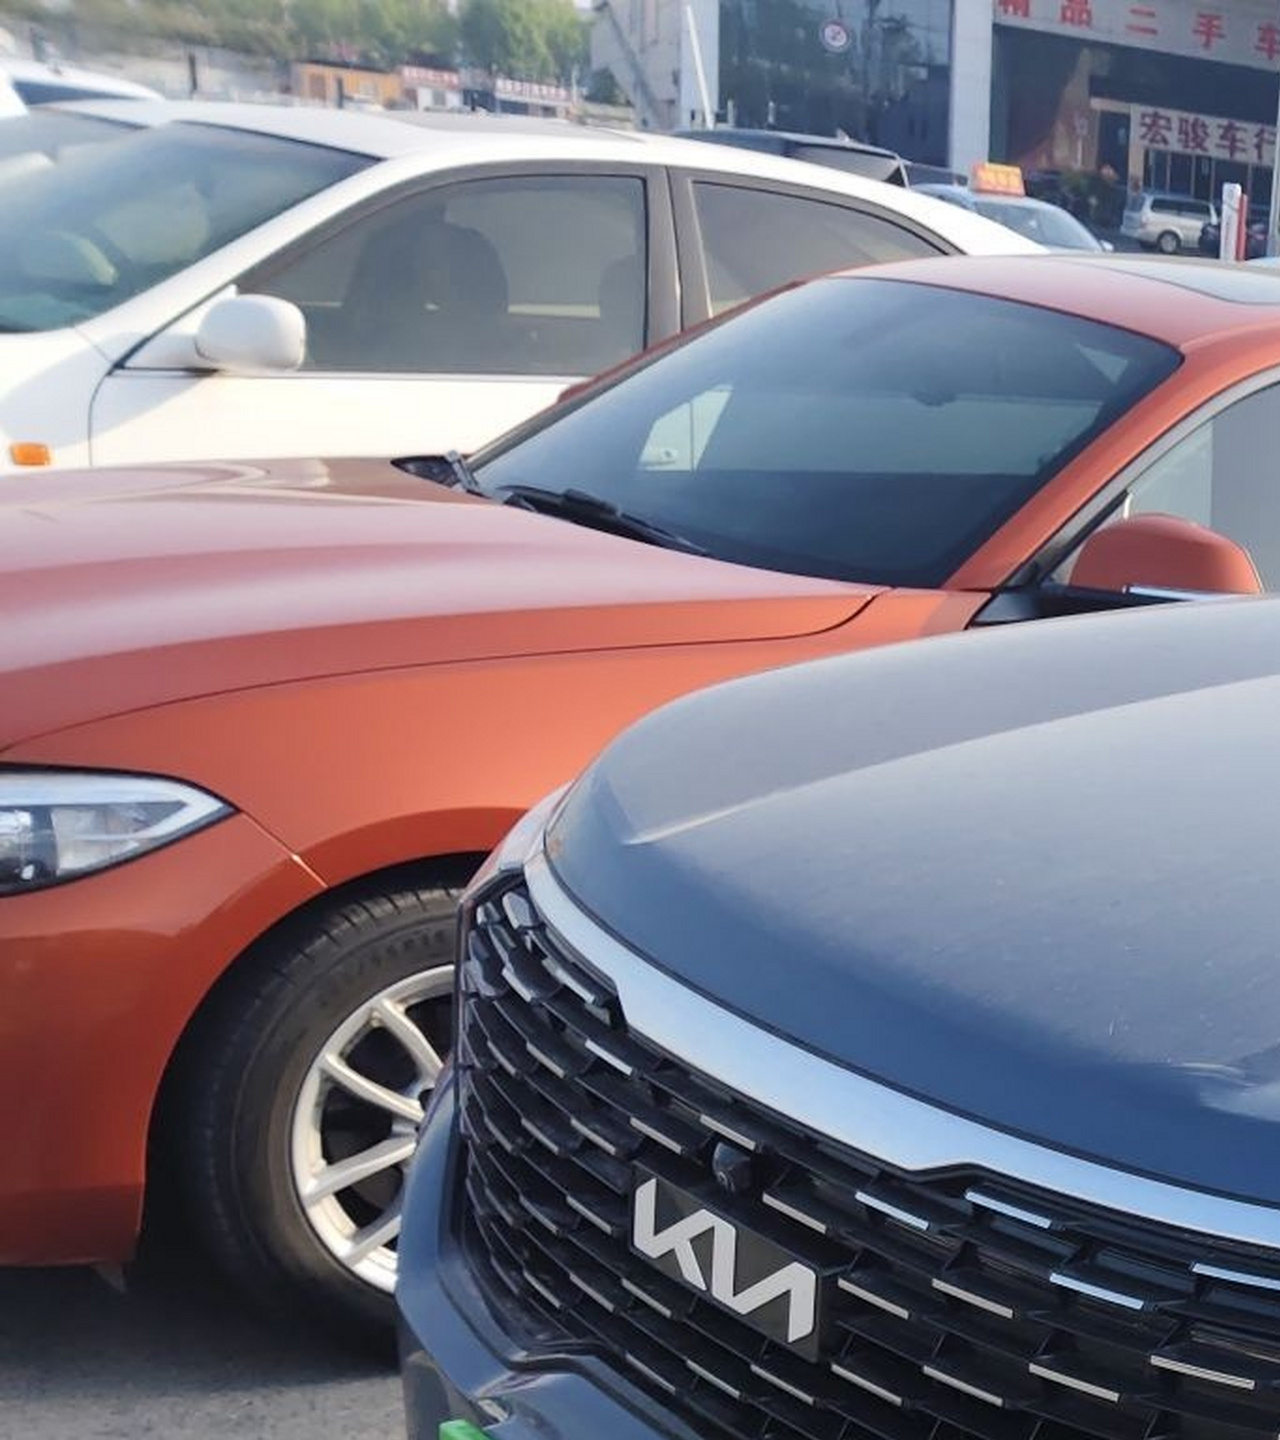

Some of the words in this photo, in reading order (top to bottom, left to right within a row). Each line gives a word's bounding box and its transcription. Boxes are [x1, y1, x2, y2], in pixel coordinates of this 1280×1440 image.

[1139, 110, 1278, 161] 宏骏车行
[633, 1177, 816, 1343] KIA
